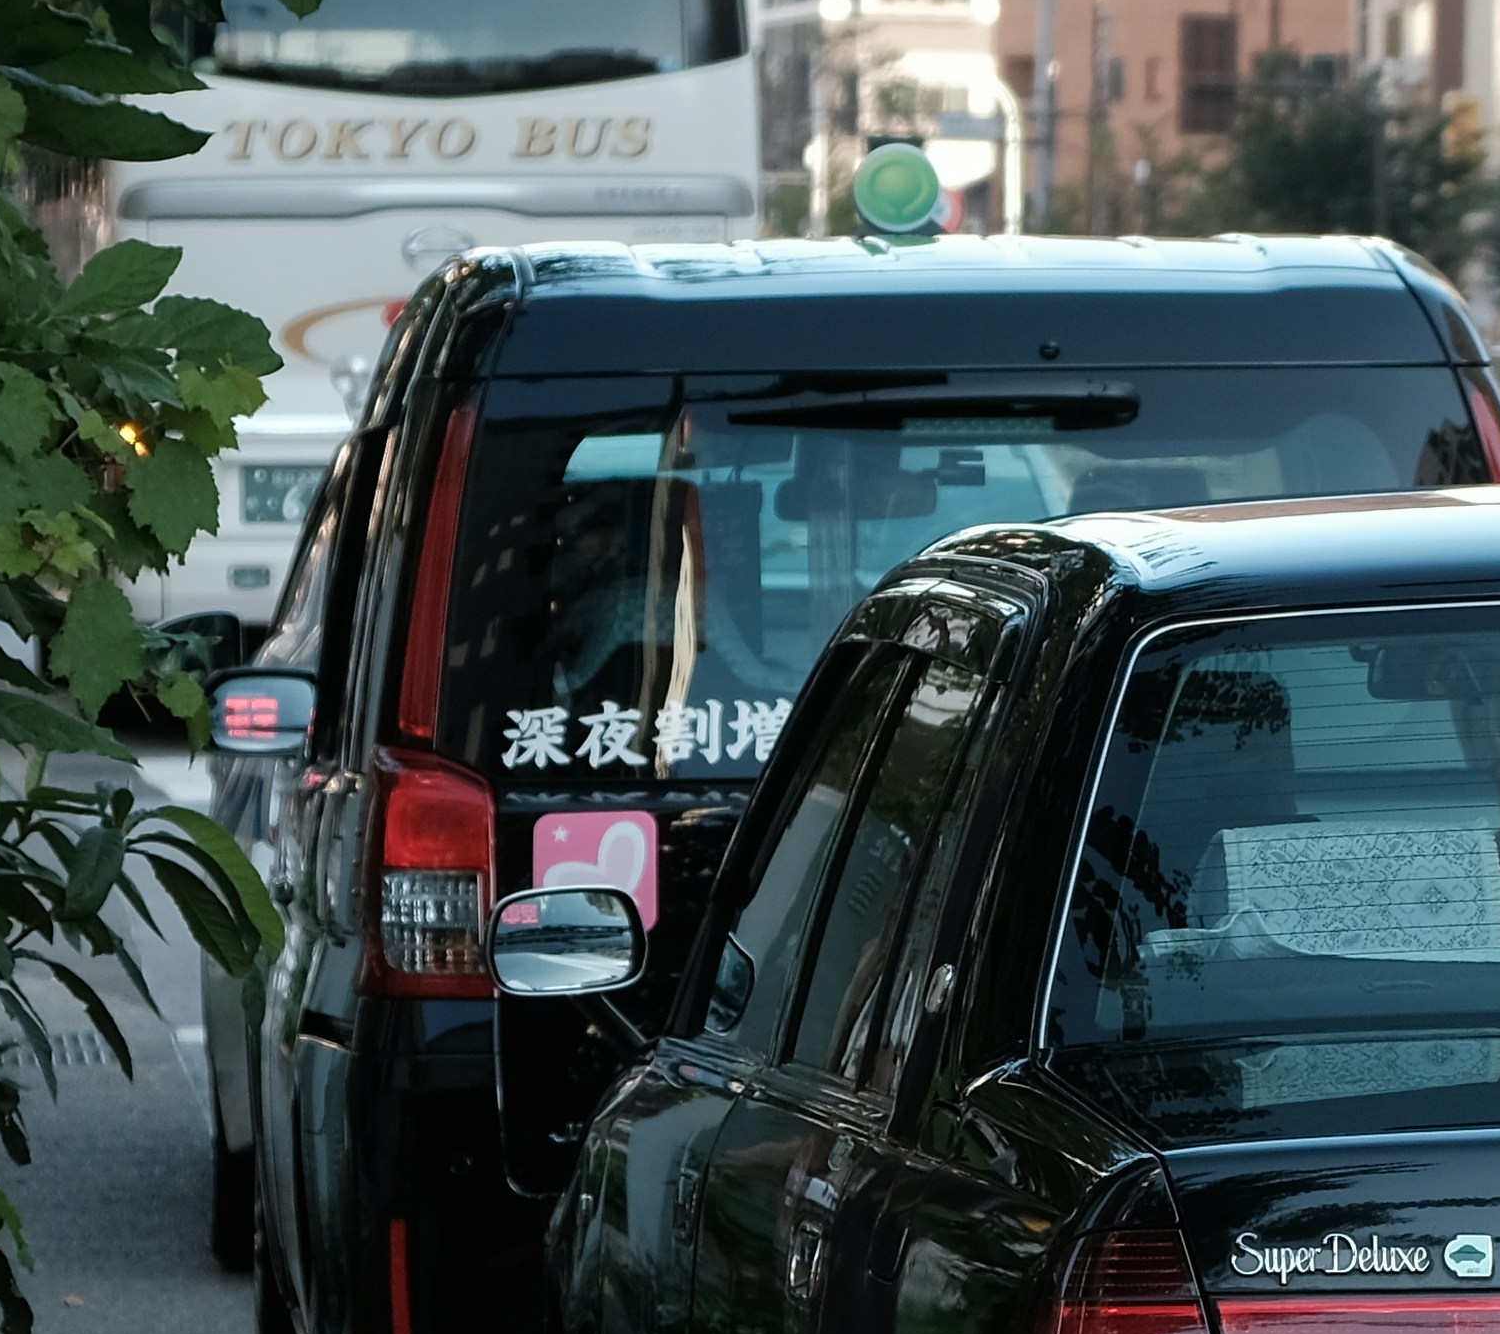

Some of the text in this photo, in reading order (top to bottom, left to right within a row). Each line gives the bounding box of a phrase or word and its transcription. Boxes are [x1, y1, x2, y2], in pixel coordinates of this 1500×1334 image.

[224, 115, 654, 161] TOKYO BUS
[502, 699, 793, 769] 深夜割増
